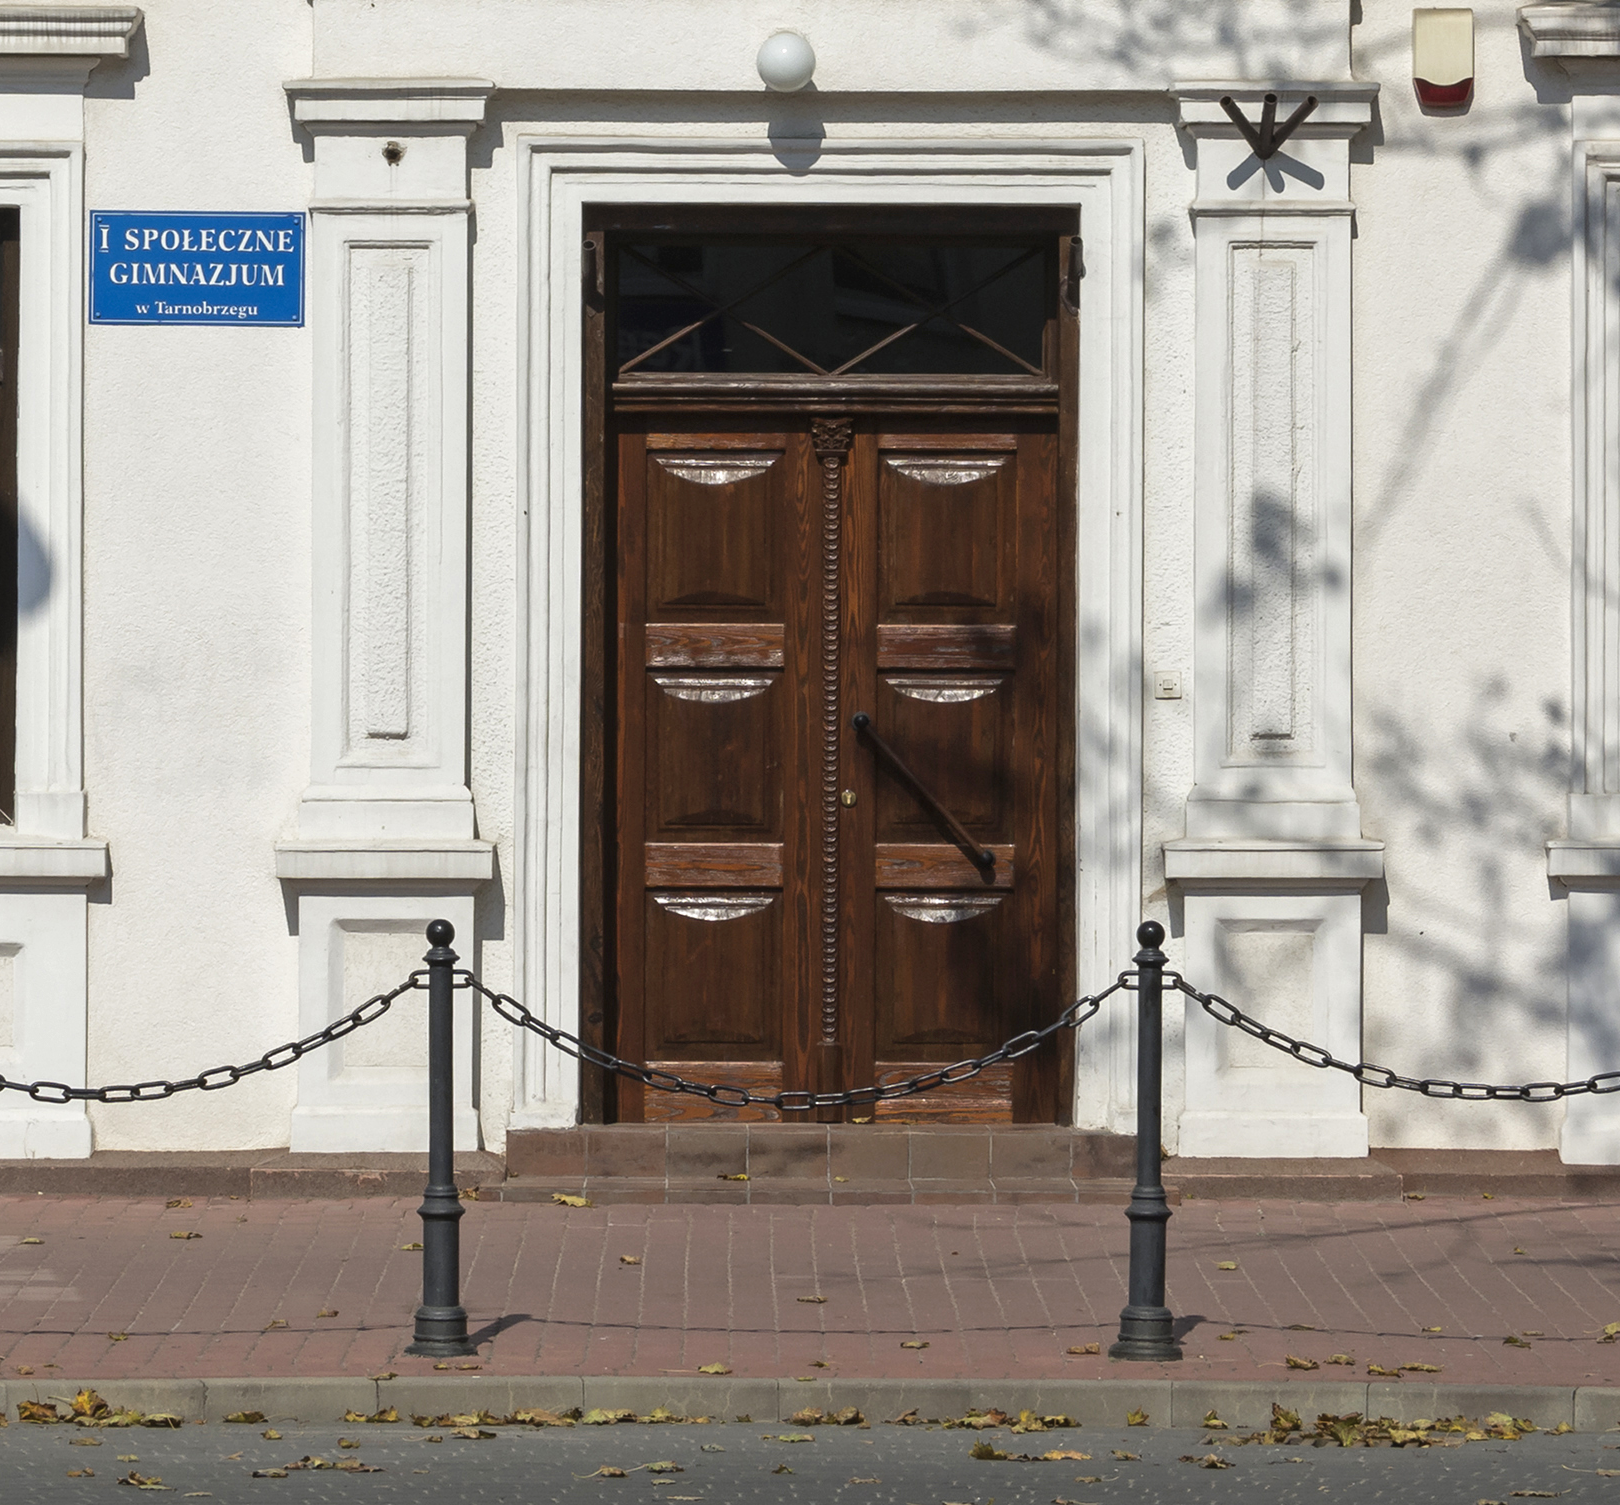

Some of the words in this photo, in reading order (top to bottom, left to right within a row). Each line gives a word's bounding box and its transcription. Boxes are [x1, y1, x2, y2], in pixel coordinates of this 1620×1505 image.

[98, 224, 110, 253] I
[124, 228, 295, 253] SPOŁECZNE
[109, 262, 285, 286] GIMNAZJUM
[136, 303, 150, 314] w
[154, 301, 258, 319] Tarnobrzegu
